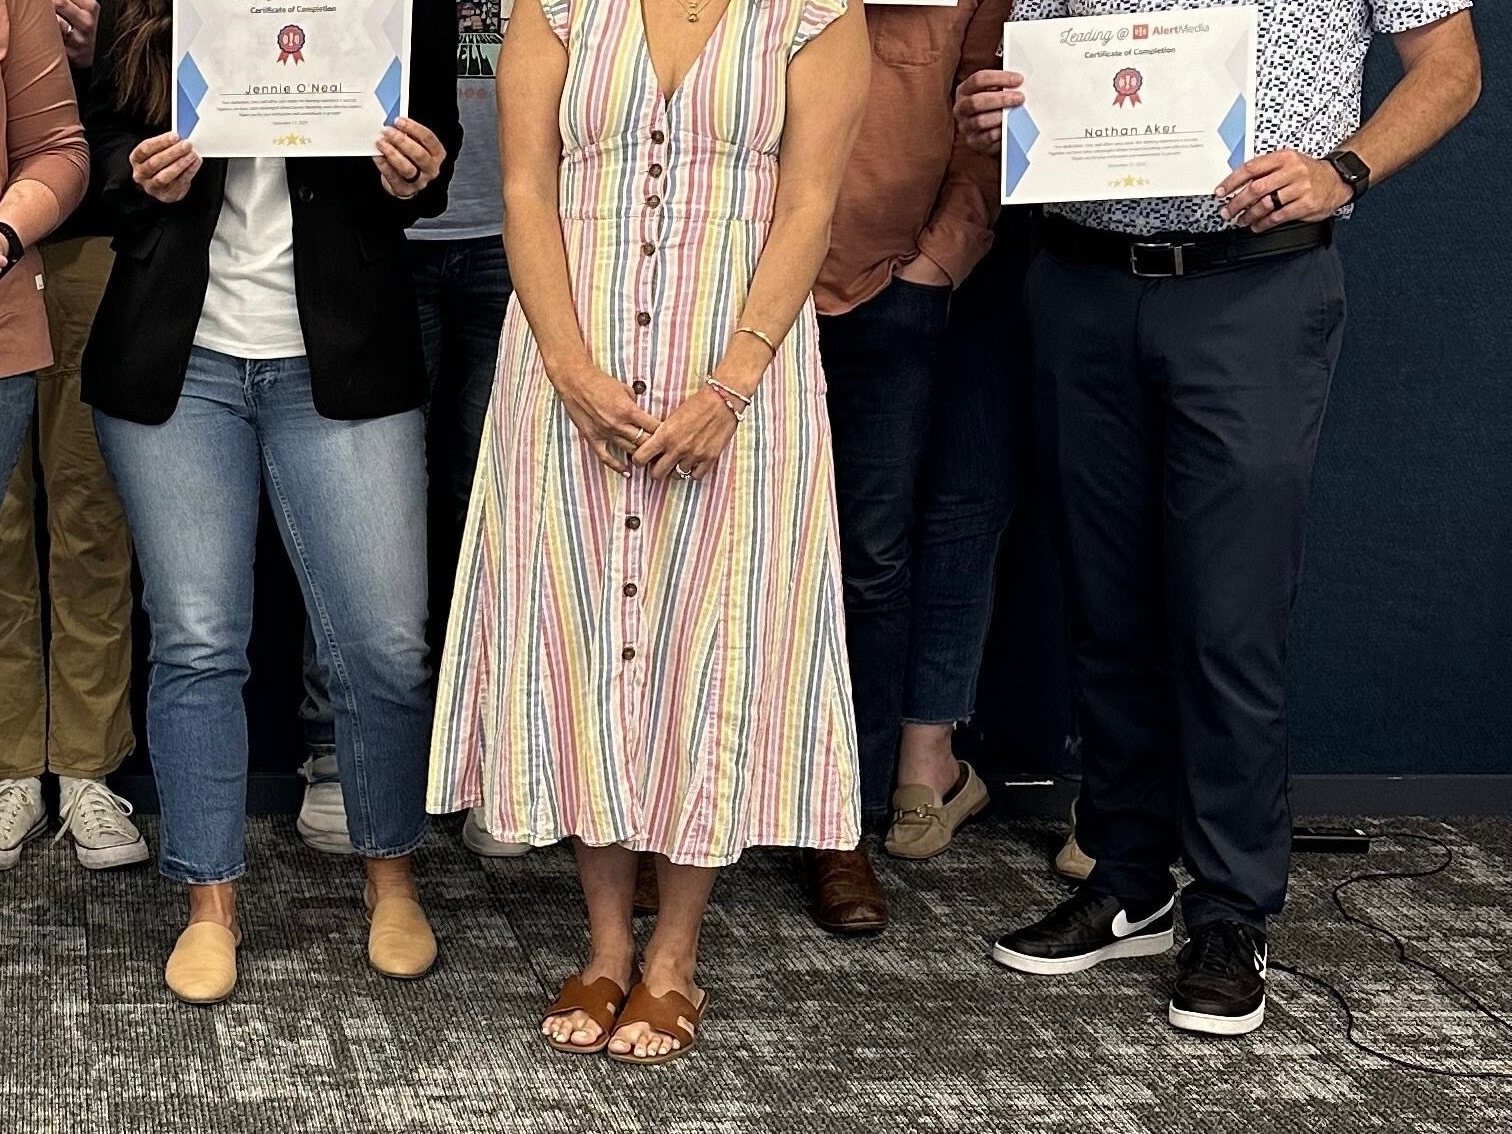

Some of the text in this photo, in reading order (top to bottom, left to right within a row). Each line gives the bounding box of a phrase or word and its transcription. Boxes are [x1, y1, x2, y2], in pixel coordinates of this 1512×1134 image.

[1060, 24, 1209, 46] Leading @ AlertMedia
[245, 83, 342, 94] Jennie O'Neal
[1085, 124, 1176, 137] Nathan Aker
